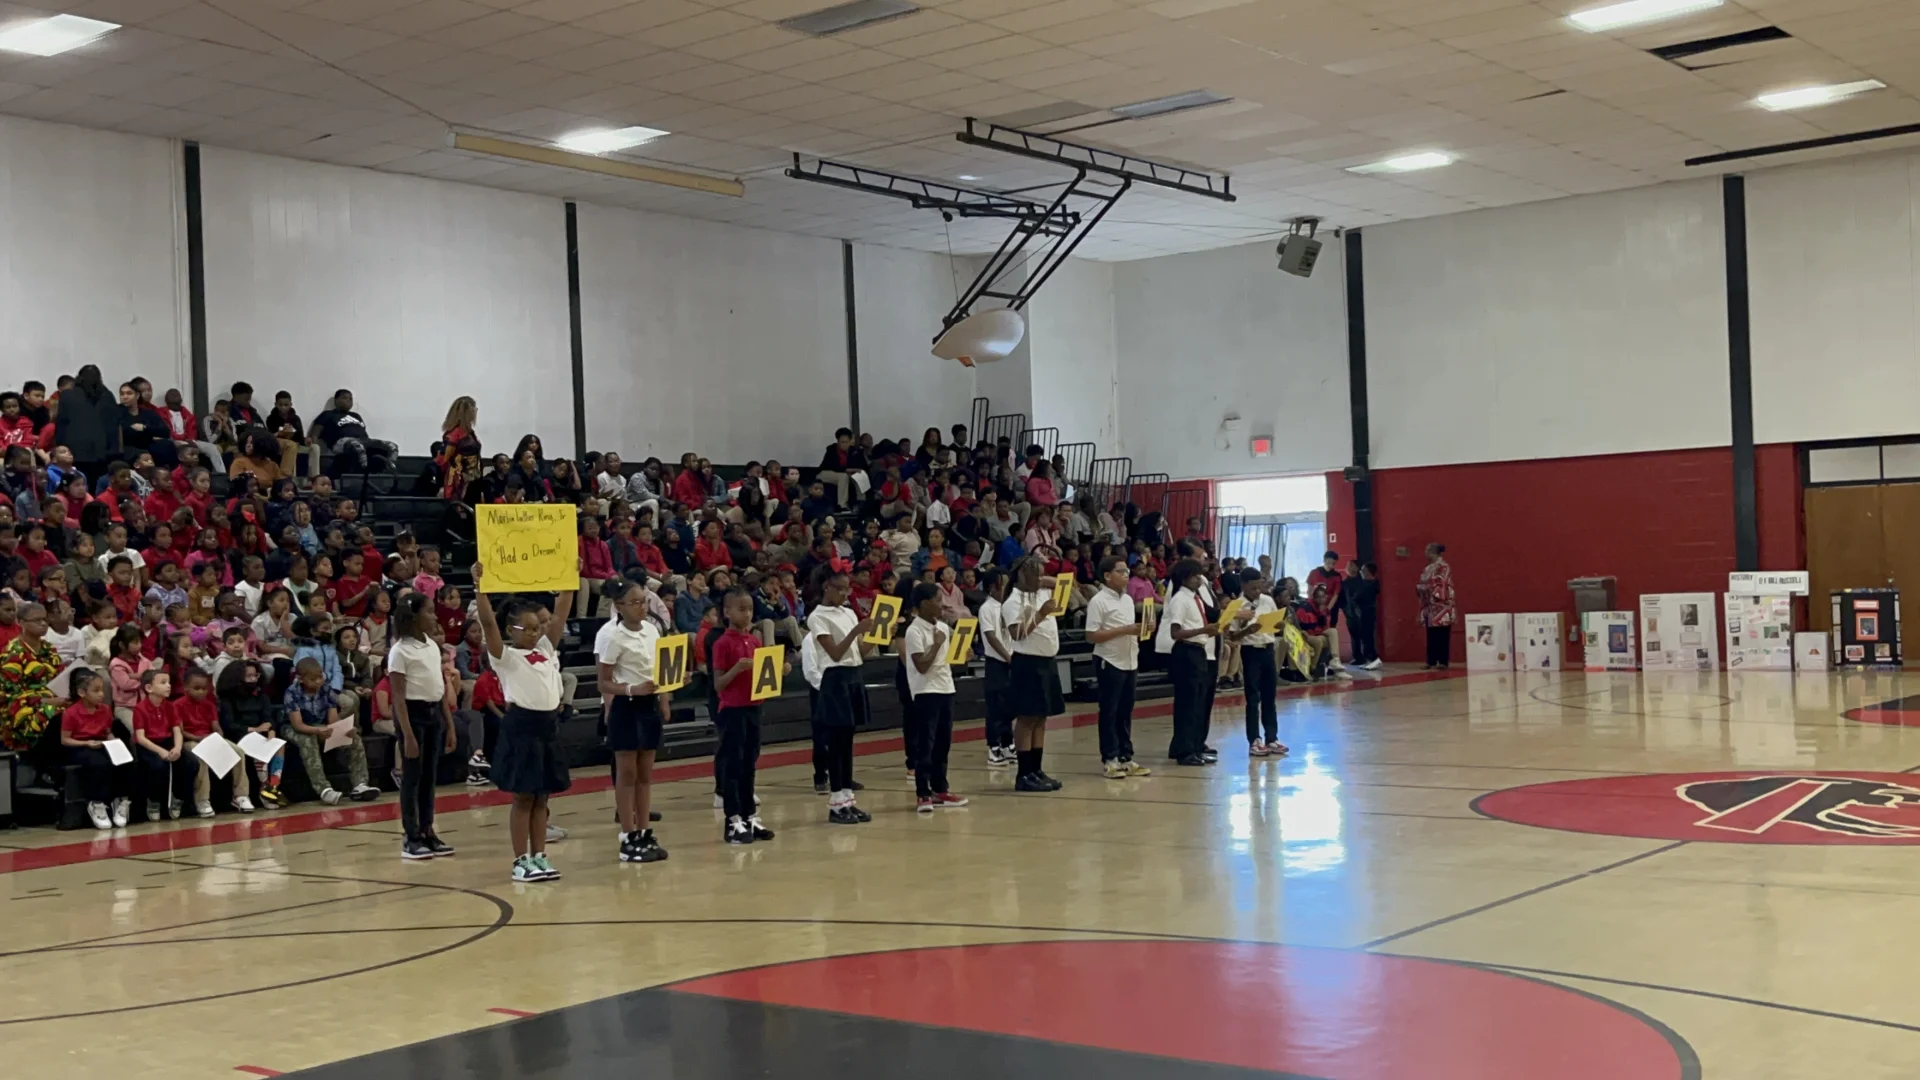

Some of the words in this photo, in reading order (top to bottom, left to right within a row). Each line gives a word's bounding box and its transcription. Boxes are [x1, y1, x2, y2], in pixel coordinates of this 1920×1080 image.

[521, 552, 528, 561] a
[869, 602, 894, 640] R
[953, 626, 972, 660] T
[658, 645, 684, 686] M
[754, 655, 778, 694] A
